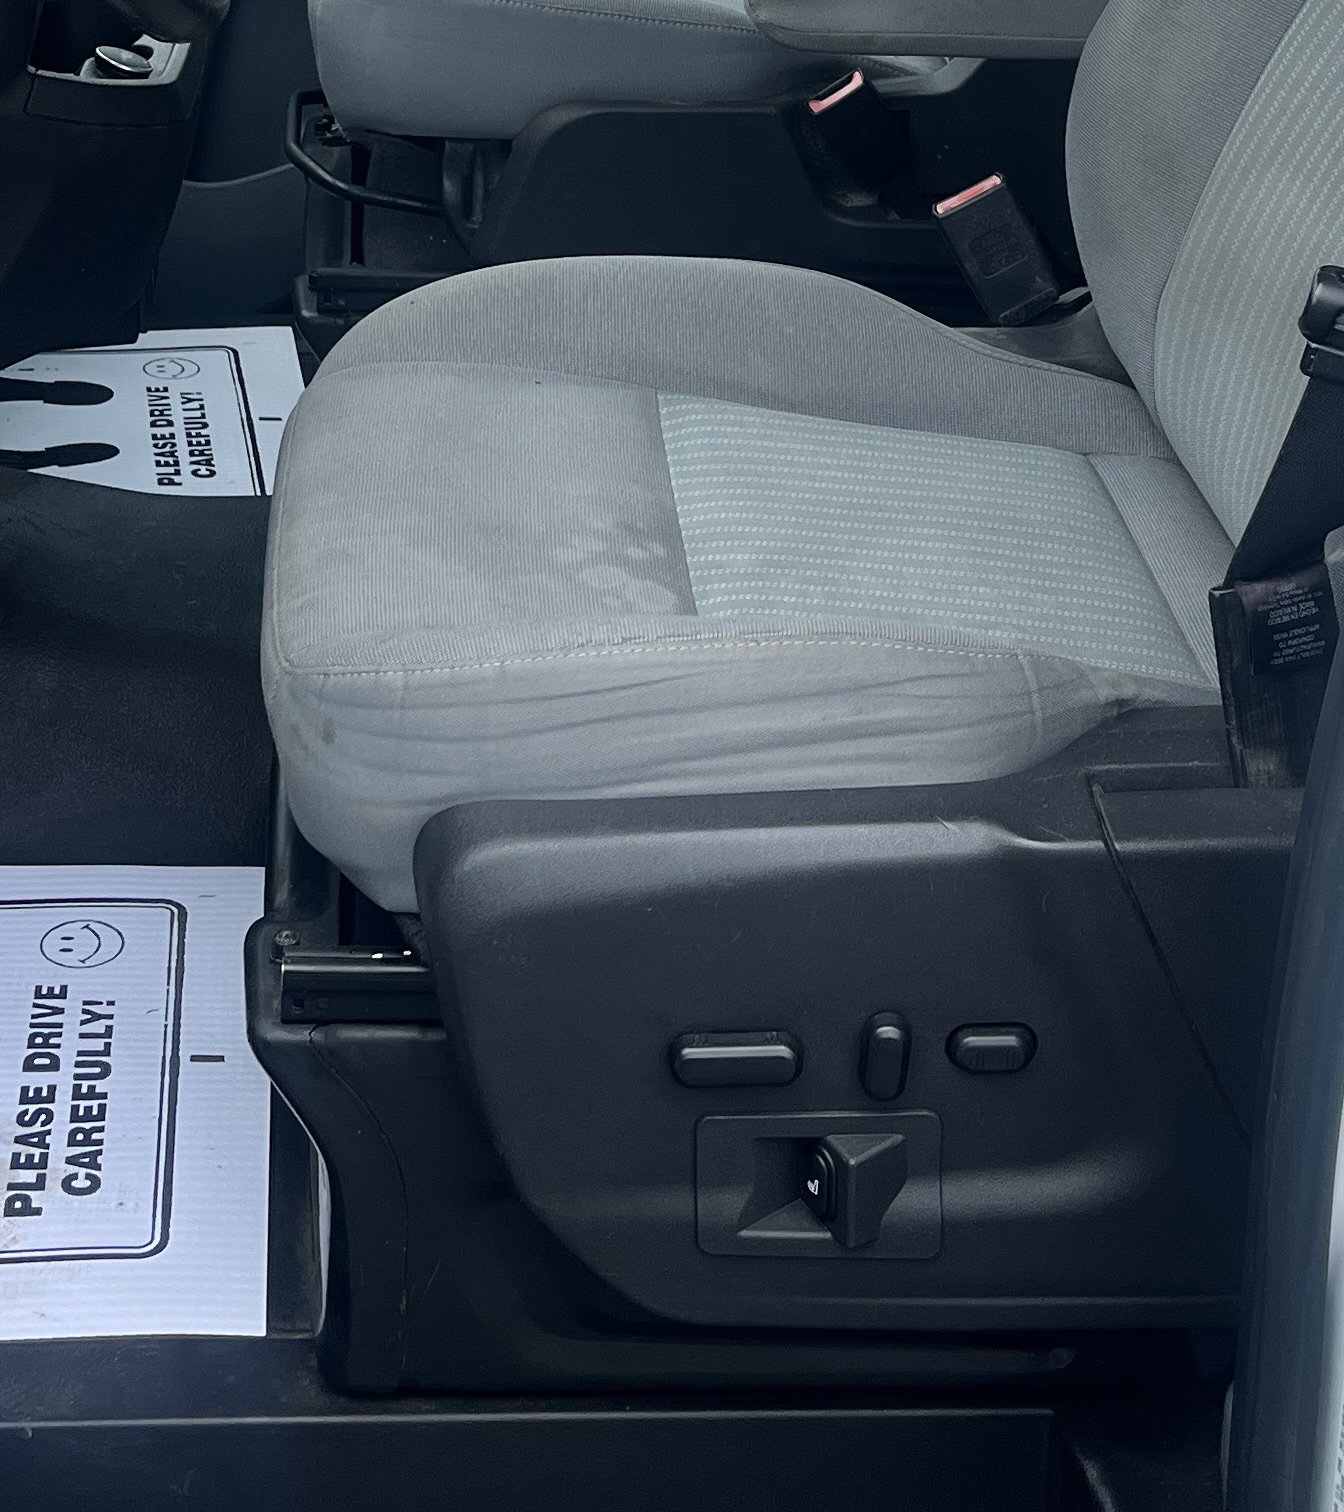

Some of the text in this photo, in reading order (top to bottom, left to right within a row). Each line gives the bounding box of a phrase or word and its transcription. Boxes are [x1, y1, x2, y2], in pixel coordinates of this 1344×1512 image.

[146, 386, 183, 486] PLEASE DRIVE
[179, 392, 217, 478] CAREFULLY!
[3, 984, 68, 1218] PLEASE DRIVE
[60, 999, 116, 1197] CAREFULLY!
